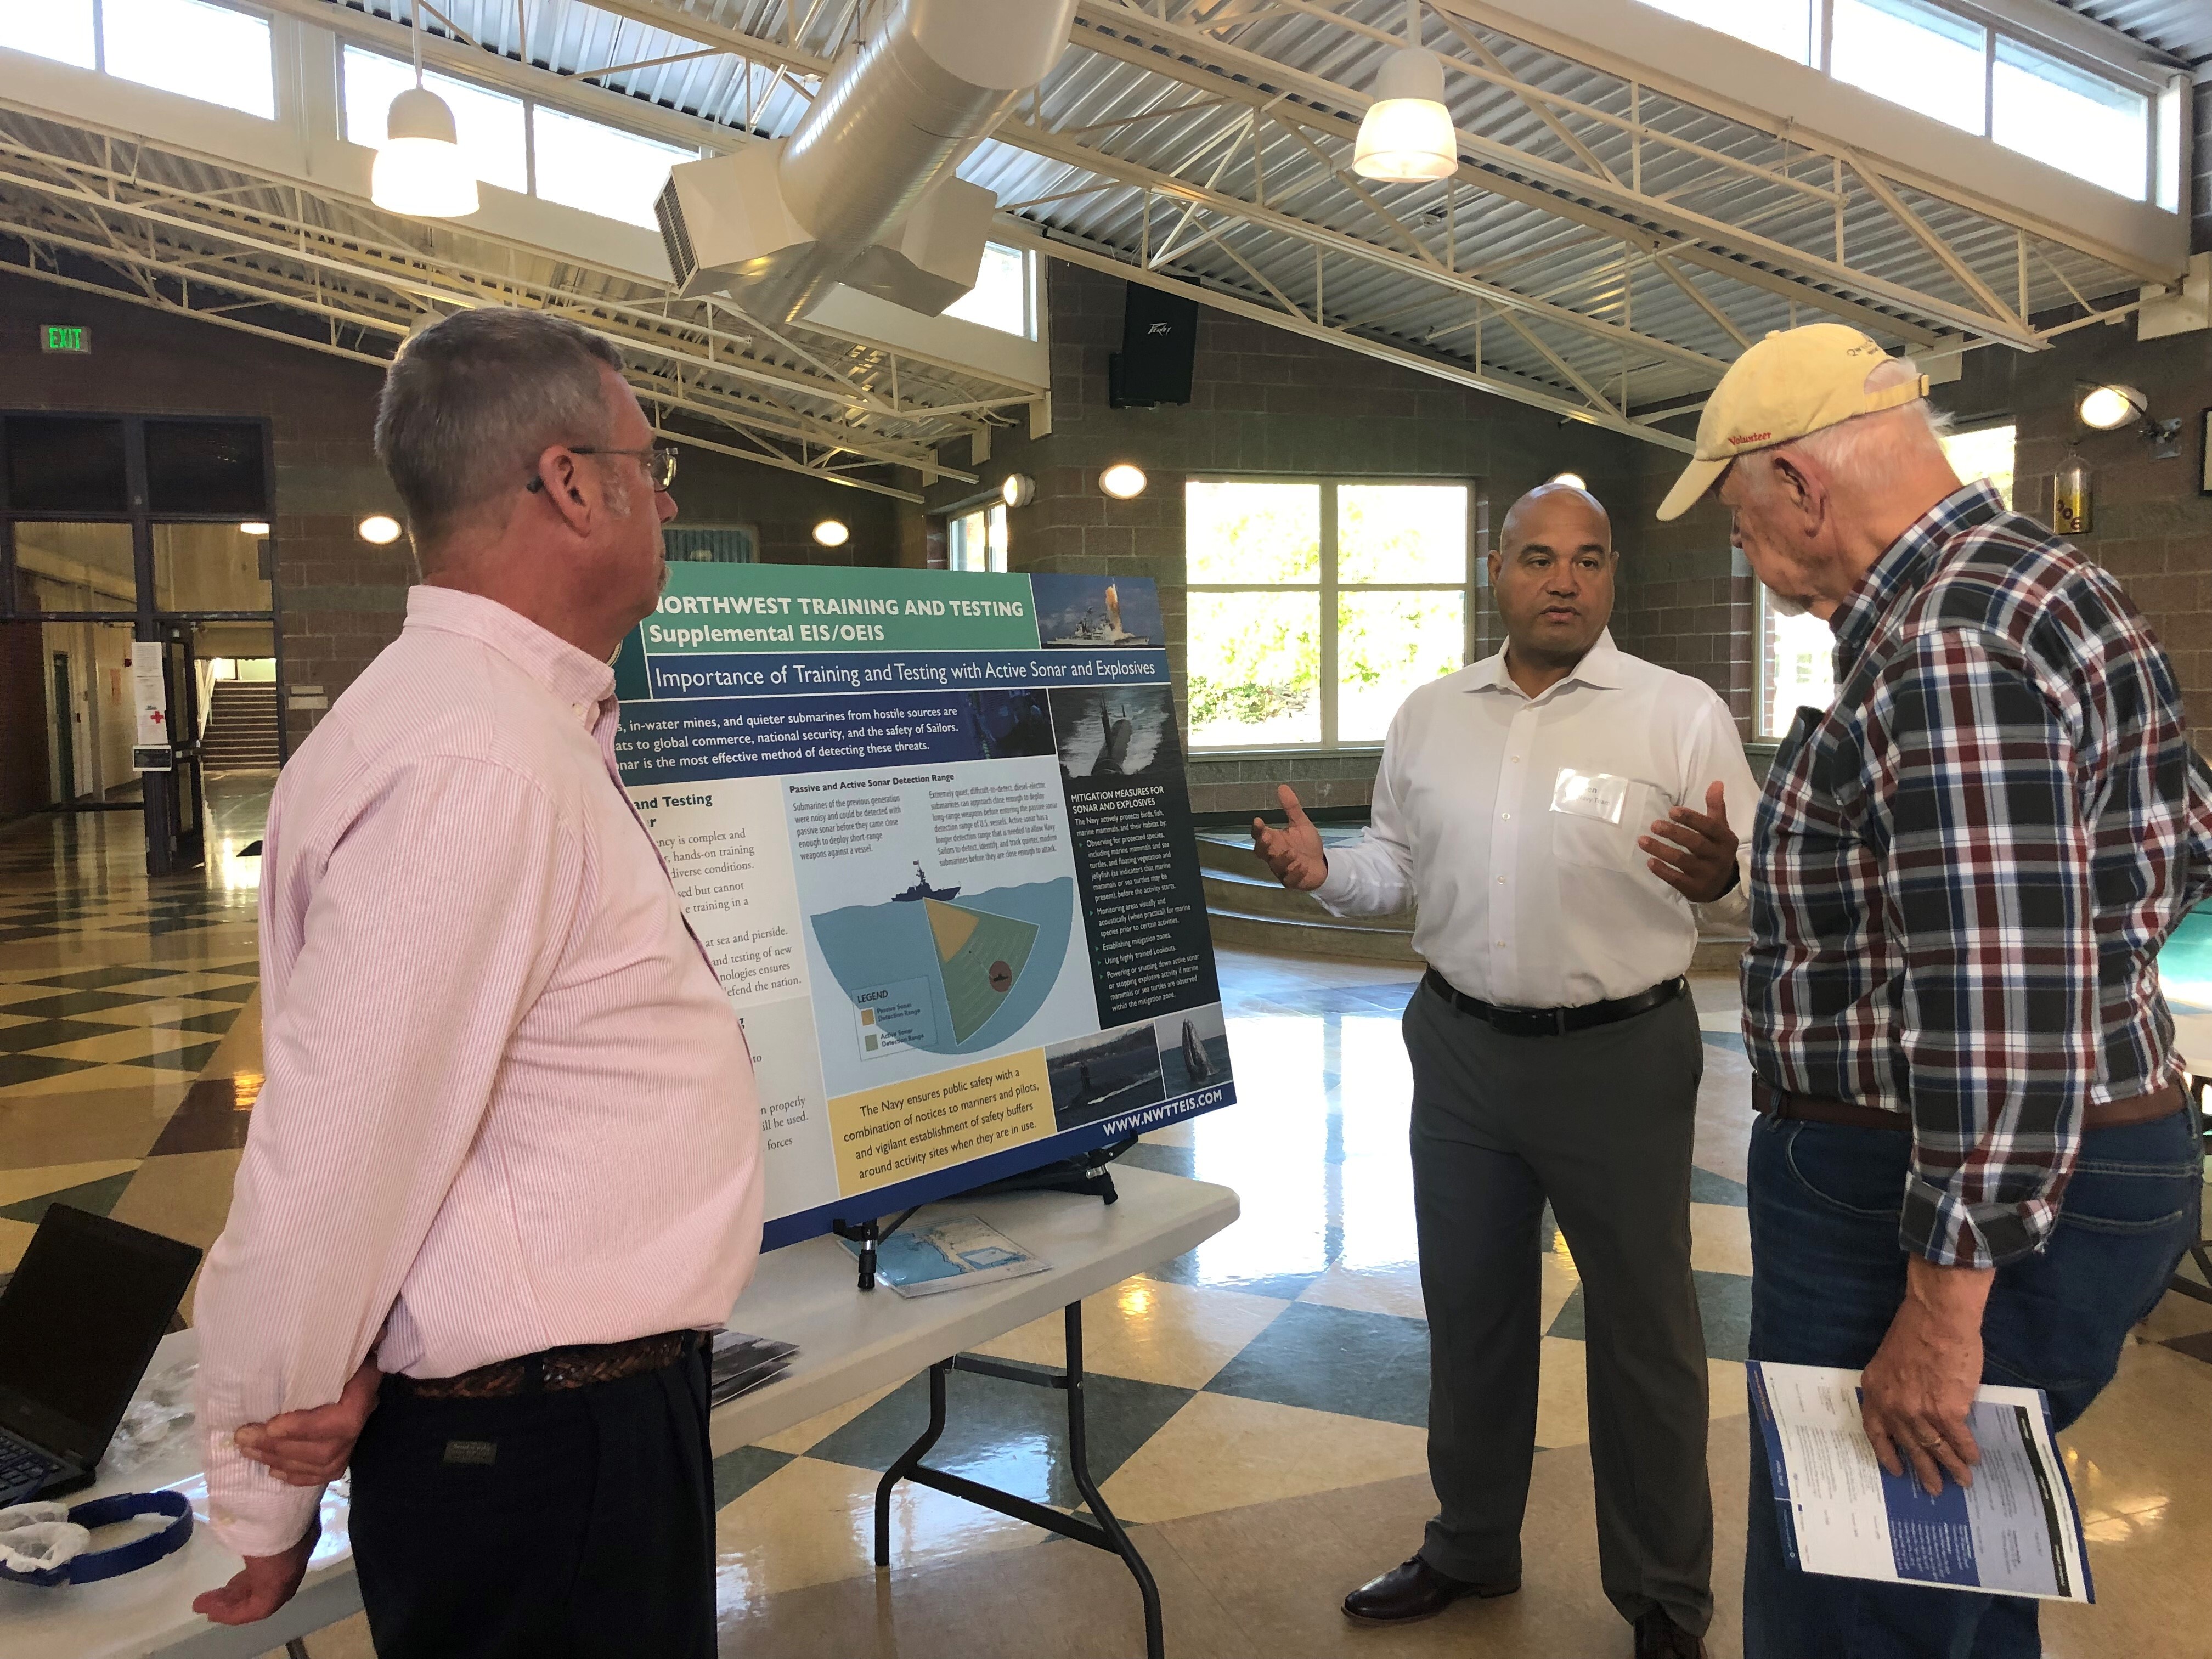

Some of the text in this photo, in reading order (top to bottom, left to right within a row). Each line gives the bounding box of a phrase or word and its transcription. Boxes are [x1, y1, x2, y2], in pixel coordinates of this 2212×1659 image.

[49, 328, 82, 349] EXIT
[1728, 432, 1771, 445] Volunteer
[656, 596, 1023, 616] NORTHWEST TRAINING AND TESTING
[650, 625, 884, 647] Supplemental EIS/OEIS
[656, 660, 1155, 692] Importance of Training and Testing with Active Sonar and Explosives
[630, 720, 679, 731] in-water
[684, 717, 720, 728] mines,
[724, 715, 743, 726] and
[747, 714, 785, 728] quieter
[788, 712, 845, 723] submarines
[848, 710, 871, 720] from
[873, 708, 905, 719] hostile
[636, 723, 958, 752] to global commerce, national security, and the safety of Sailors.
[644, 741, 929, 768] is the most effective method of detecting these threats.
[789, 785, 820, 793] Passive
[840, 781, 866, 789] Active
[893, 776, 929, 785] Detection
[662, 794, 712, 807] Testing
[1071, 786, 1164, 802] MITIGATION MEASURES FOR
[793, 802, 828, 811] Submarines
[829, 799, 834, 808] of
[847, 798, 870, 808] previous
[871, 795, 900, 806] generation
[1073, 798, 1155, 814] SONAR AND EXPLOSIVES
[811, 814, 826, 823] noisy
[827, 811, 838, 820] and
[839, 810, 855, 819] could
[856, 809, 862, 817] be
[864, 808, 888, 816] detected
[678, 828, 746, 845] is complex and
[799, 837, 821, 848] enough
[830, 835, 849, 845] deploy
[850, 833, 883, 842] short-range
[673, 849, 716, 861] hands-on
[719, 845, 754, 856] training
[800, 851, 827, 860] weapons
[828, 848, 849, 859] against
[854, 844, 873, 853] vessel.
[704, 862, 754, 874] conditions.
[695, 883, 744, 895] but cannot
[693, 900, 730, 912] training
[732, 898, 741, 906] in
[733, 930, 749, 943] and
[752, 926, 787, 943] pierside.
[731, 952, 761, 963] testing
[763, 947, 772, 957] of
[775, 947, 792, 956] new
[759, 964, 790, 974] ensures
[755, 977, 801, 991] the nation.
[857, 990, 888, 1003] LEGEND
[860, 1105, 878, 1117] The
[882, 1099, 904, 1111] Navy
[907, 1090, 940, 1104] ensures
[943, 1082, 968, 1099] public
[970, 1076, 992, 1088] safety
[995, 1069, 1013, 1081] with
[770, 1096, 805, 1115] properly
[844, 1120, 900, 1142] combination
[904, 1114, 912, 1126] of
[916, 1108, 946, 1122] notices
[961, 1094, 996, 1110] mariners
[1000, 1087, 1013, 1100] and
[1015, 1084, 1039, 1098] pilots,
[1103, 1089, 1222, 1136] WWW.NWTTEIS.COM
[774, 1110, 809, 1128] be used.
[856, 1103, 1033, 1159] and vigilant establishment of safety buffers
[768, 1138, 793, 1150] forces
[860, 1122, 1036, 1179] around activity sites when they are in use.
